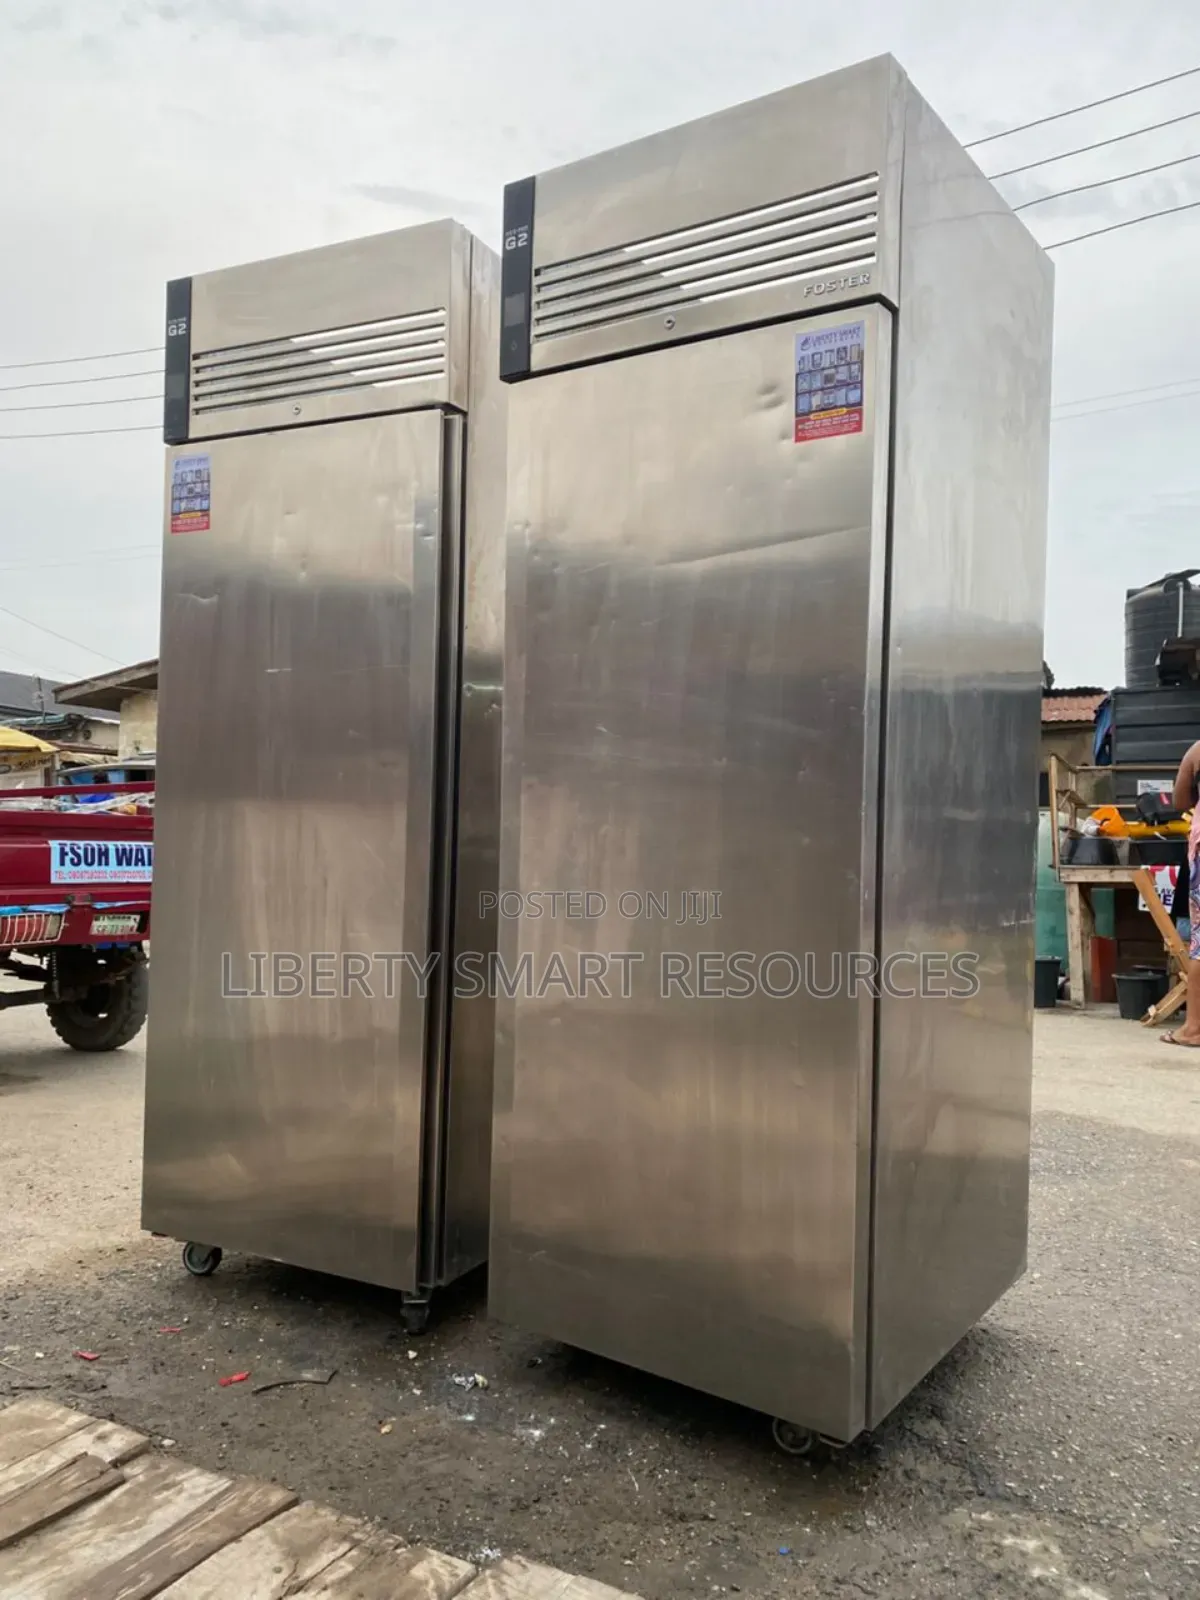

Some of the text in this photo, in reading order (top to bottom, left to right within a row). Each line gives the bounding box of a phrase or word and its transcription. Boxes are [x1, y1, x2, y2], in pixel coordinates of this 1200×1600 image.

[505, 233, 528, 250] G2
[803, 273, 871, 298] FOSTER
[168, 323, 187, 337] G2
